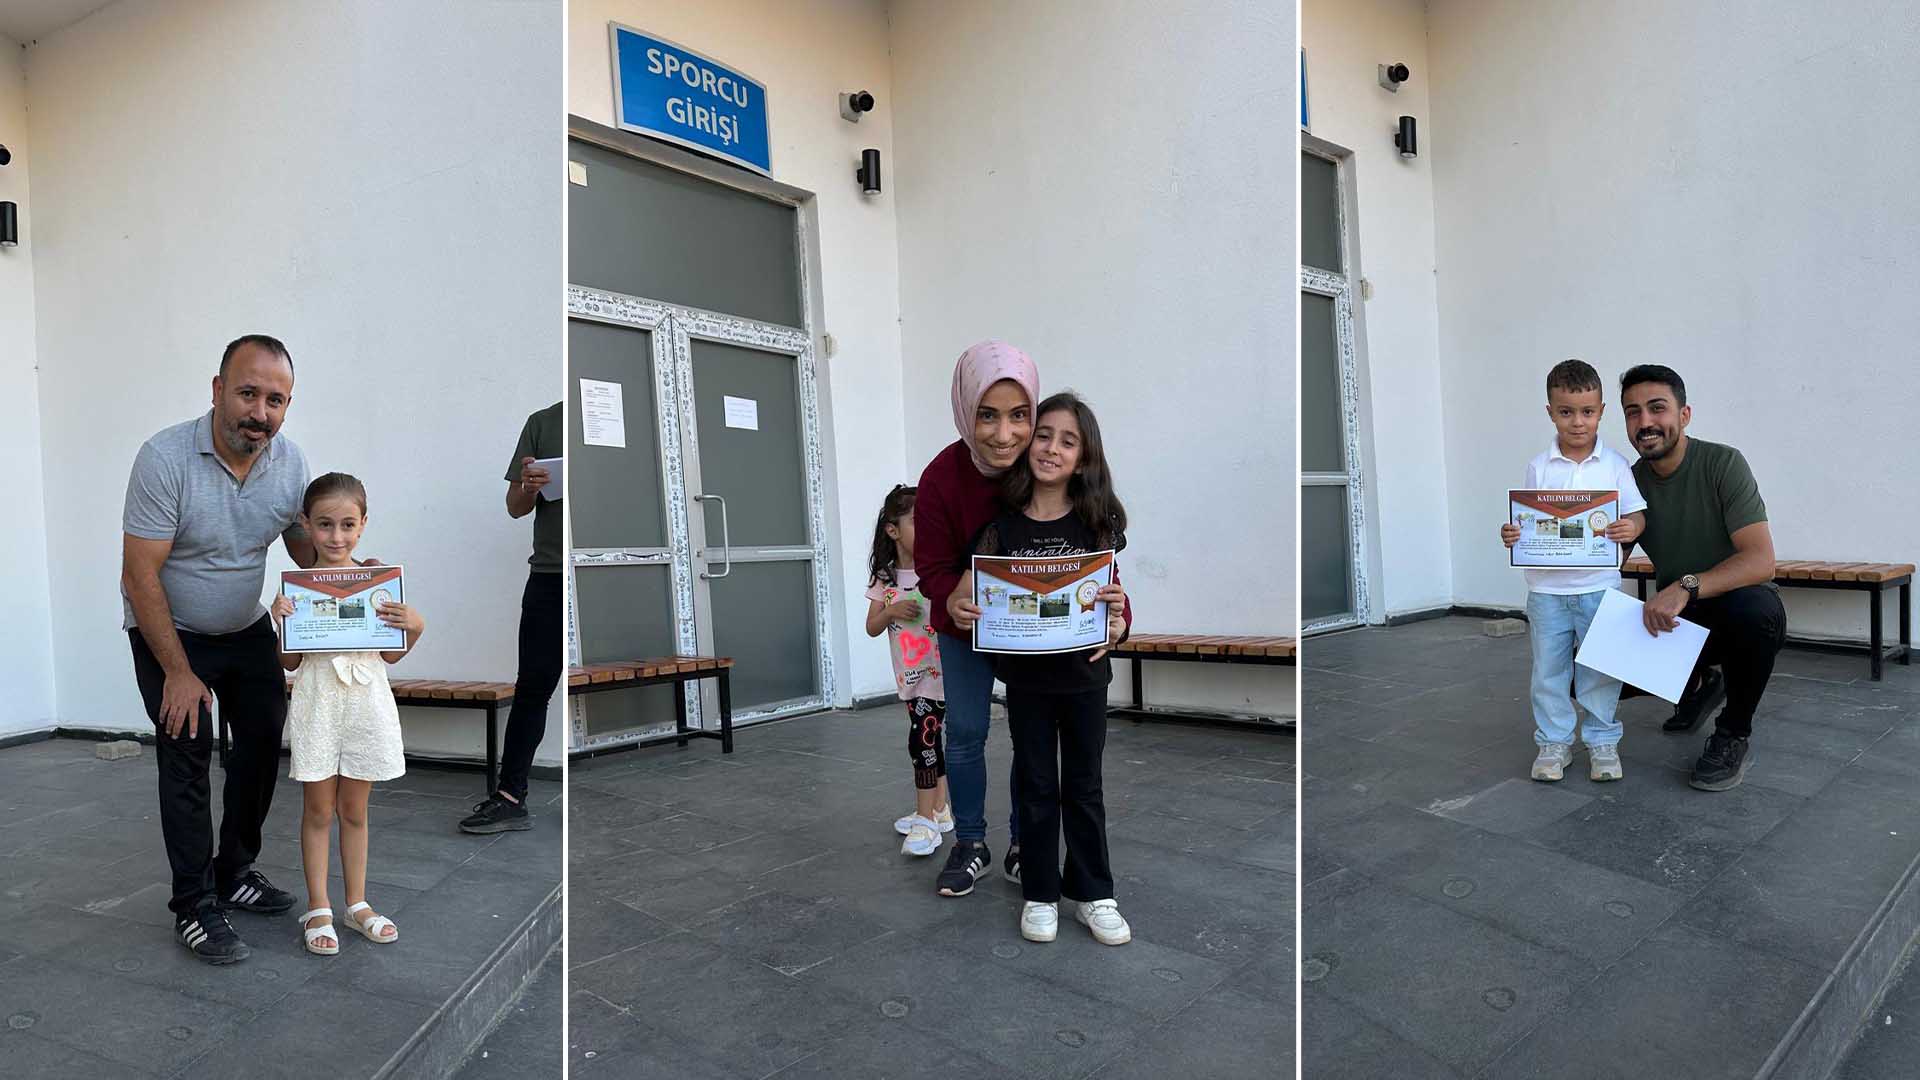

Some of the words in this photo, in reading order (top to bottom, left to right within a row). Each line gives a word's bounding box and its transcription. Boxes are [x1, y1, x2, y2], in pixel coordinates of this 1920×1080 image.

[646, 48, 748, 108] SPORCU
[666, 97, 740, 146] GİRİŞİ
[312, 574, 342, 582] KATILIM
[343, 571, 371, 581] BELGESİ
[1011, 564, 1046, 574] KATILIM
[1047, 560, 1080, 573] BELGESİ
